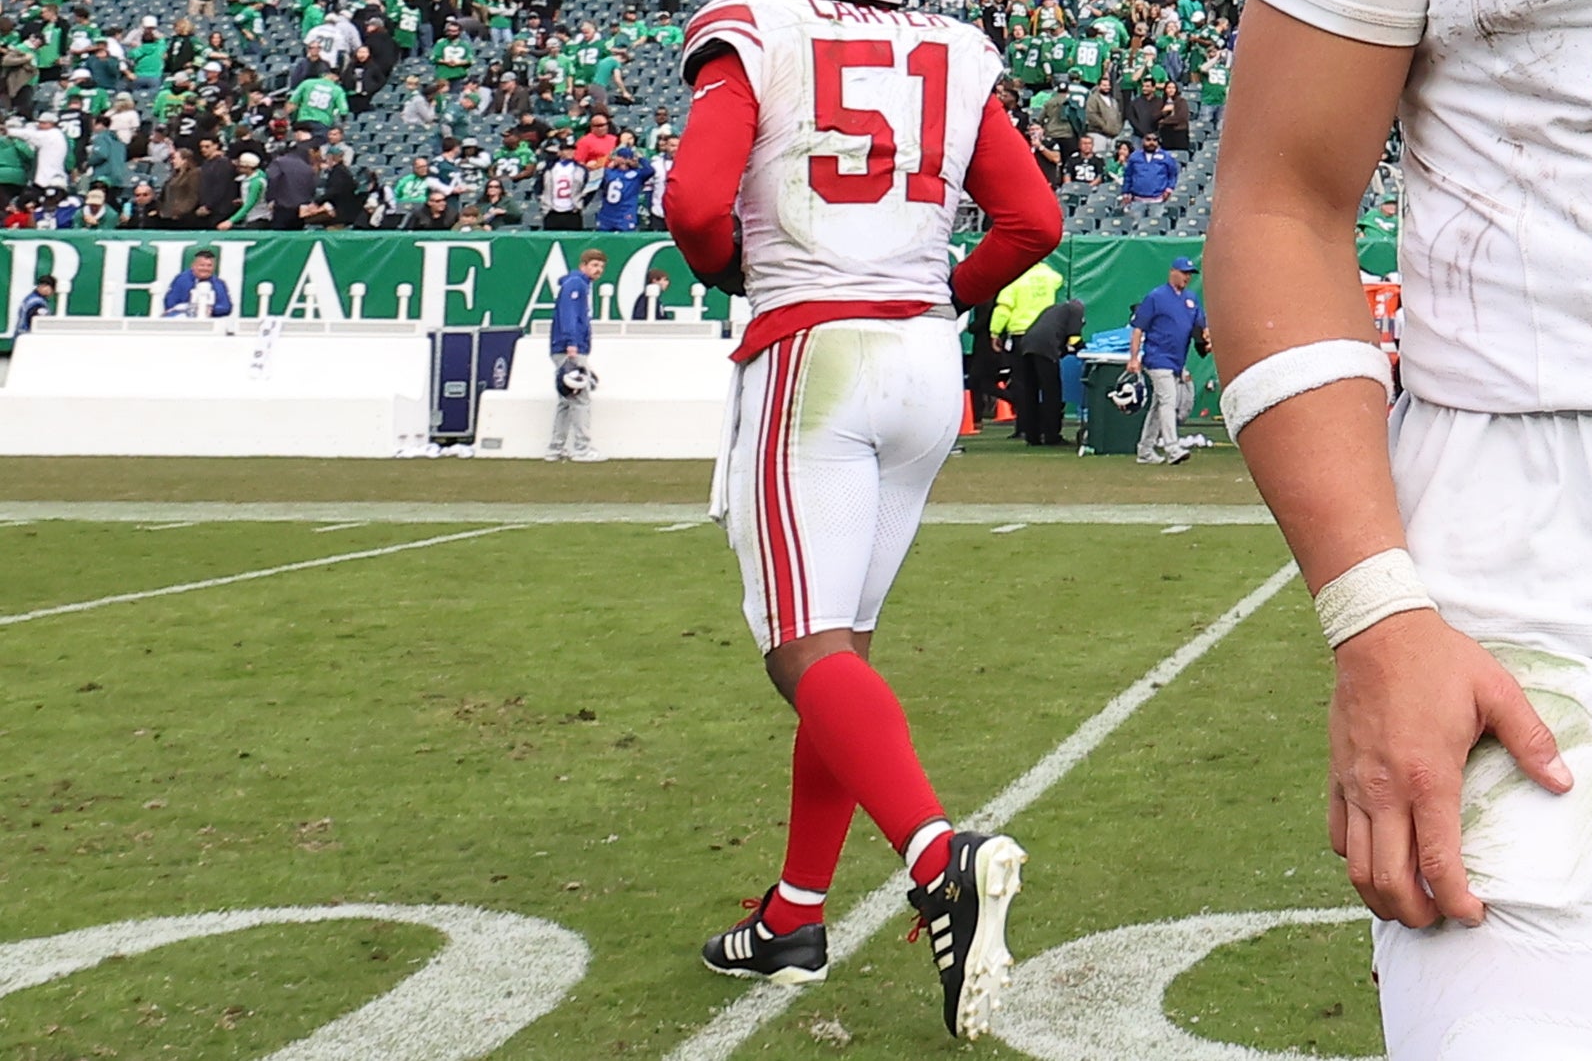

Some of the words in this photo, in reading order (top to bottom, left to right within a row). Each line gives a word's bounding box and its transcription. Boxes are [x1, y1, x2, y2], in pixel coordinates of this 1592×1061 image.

[578, 47, 599, 65] 12
[1077, 46, 1099, 66] 88
[808, 38, 949, 206] 51
[1074, 165, 1096, 181] 26
[557, 179, 572, 199] 2
[606, 180, 624, 204] 6
